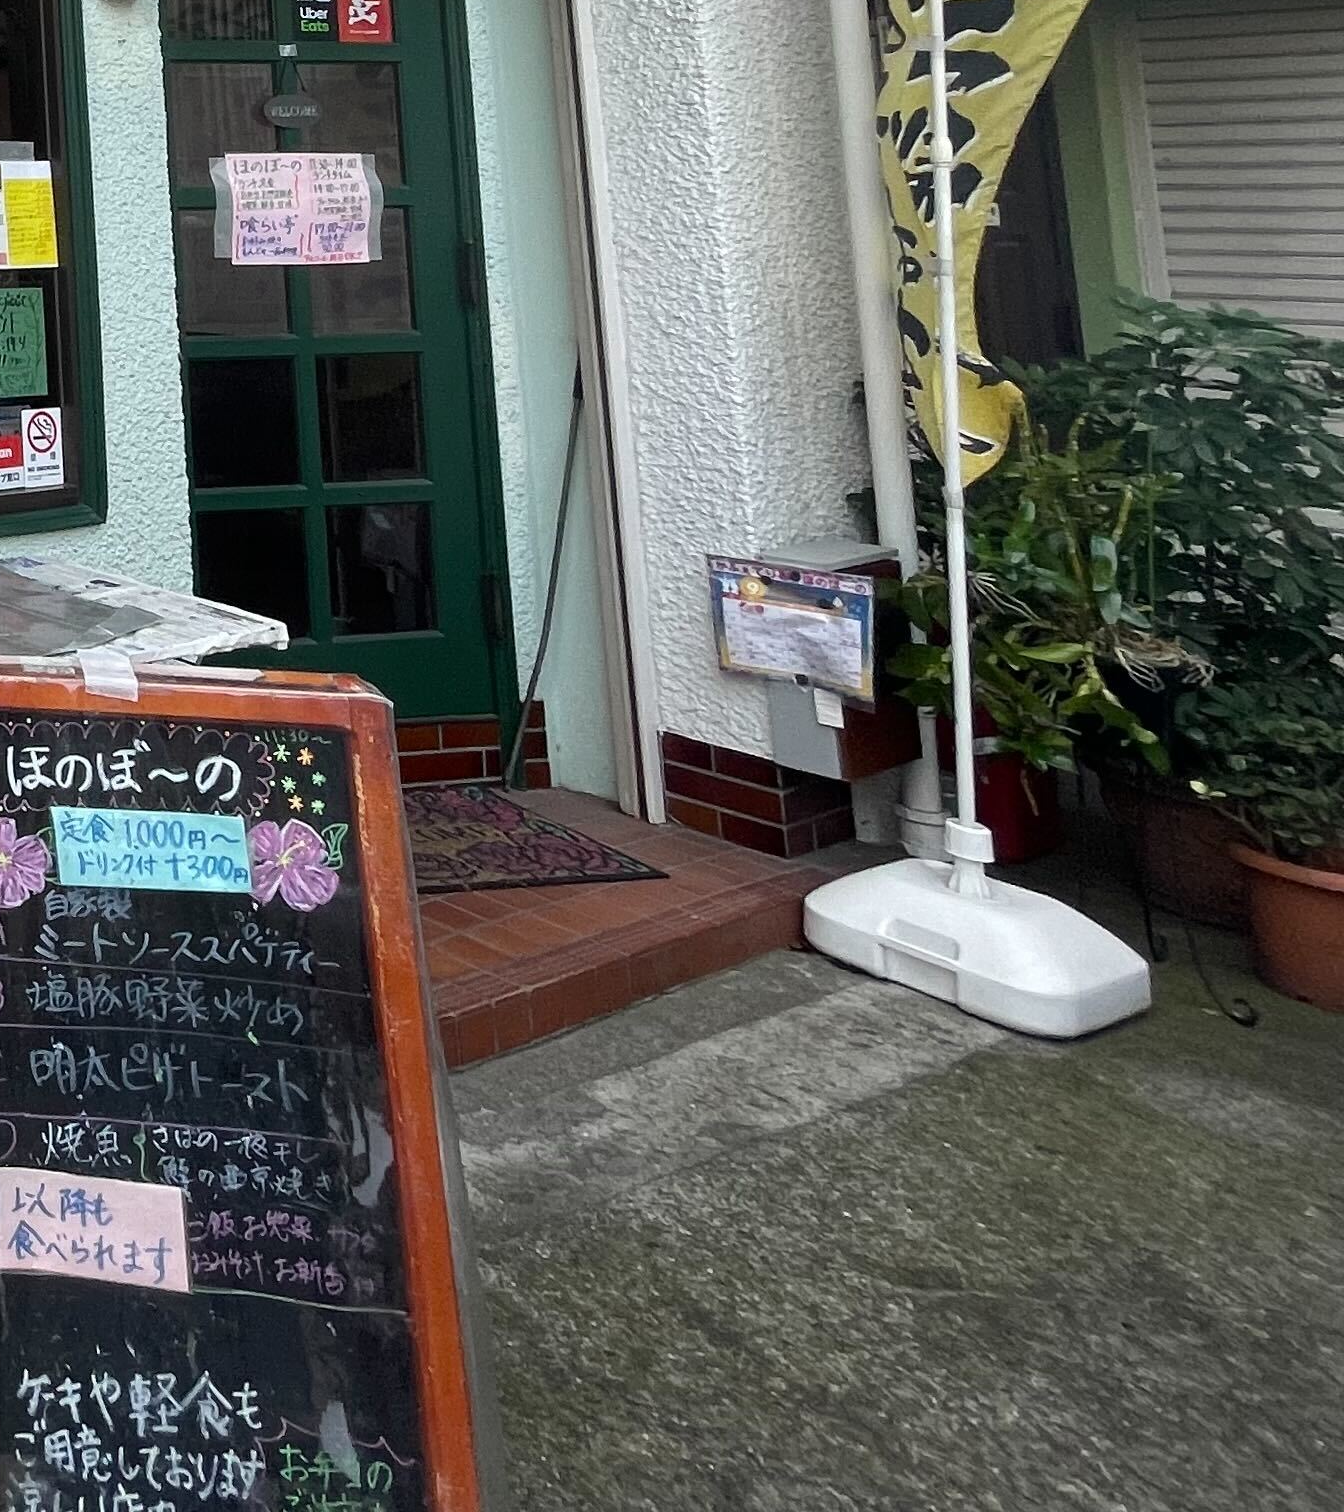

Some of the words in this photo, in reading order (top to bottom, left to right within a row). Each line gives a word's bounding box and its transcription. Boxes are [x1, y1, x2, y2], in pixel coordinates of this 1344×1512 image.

[300, 7, 328, 20] Uber
[301, 21, 330, 33] Eats
[60, 811, 114, 844] 定食
[25, 971, 304, 1036] 塩豚野菜炒め
[41, 1122, 132, 1166] 焼魚
